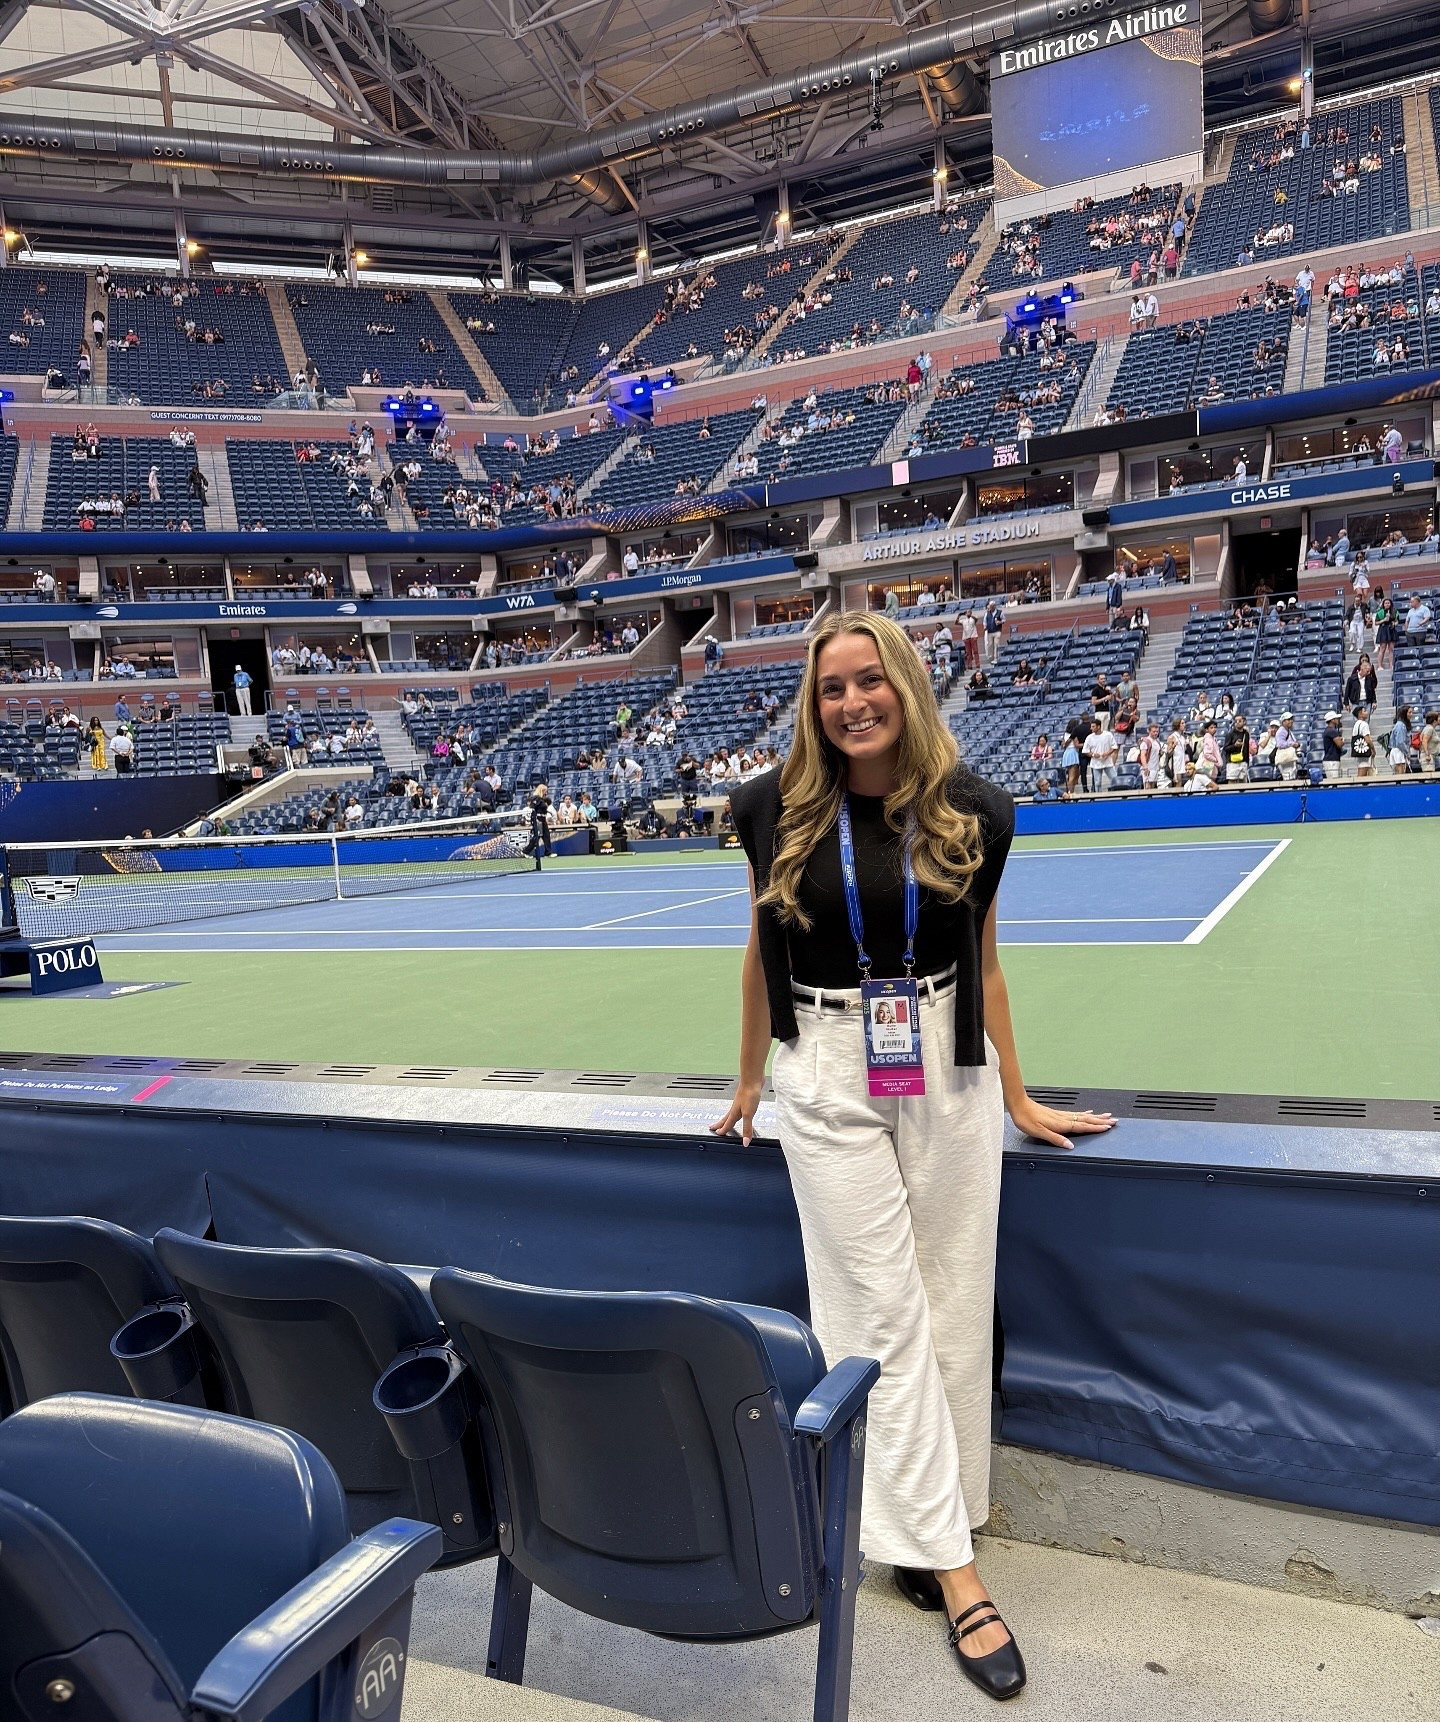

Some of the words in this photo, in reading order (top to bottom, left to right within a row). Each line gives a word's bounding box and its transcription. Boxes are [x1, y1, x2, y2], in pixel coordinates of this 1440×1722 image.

[1000, 29, 1099, 74] Emirates
[1105, 4, 1187, 43] Airline
[171, 412, 203, 420] CONCERN?
[1231, 484, 1291, 504] CHASE
[863, 541, 920, 561] ARTHUR
[926, 533, 966, 552] ASHE
[972, 522, 1040, 545] STADIUM
[219, 604, 267, 616] Emirates
[506, 595, 535, 609] WTA
[36, 945, 97, 976] POLO
[602, 1109, 639, 1117] Please
[641, 1110, 657, 1118] Do
[681, 1111, 702, 1120] Put
[703, 1112, 725, 1120] Ite
[362, 1653, 397, 1710] AA
